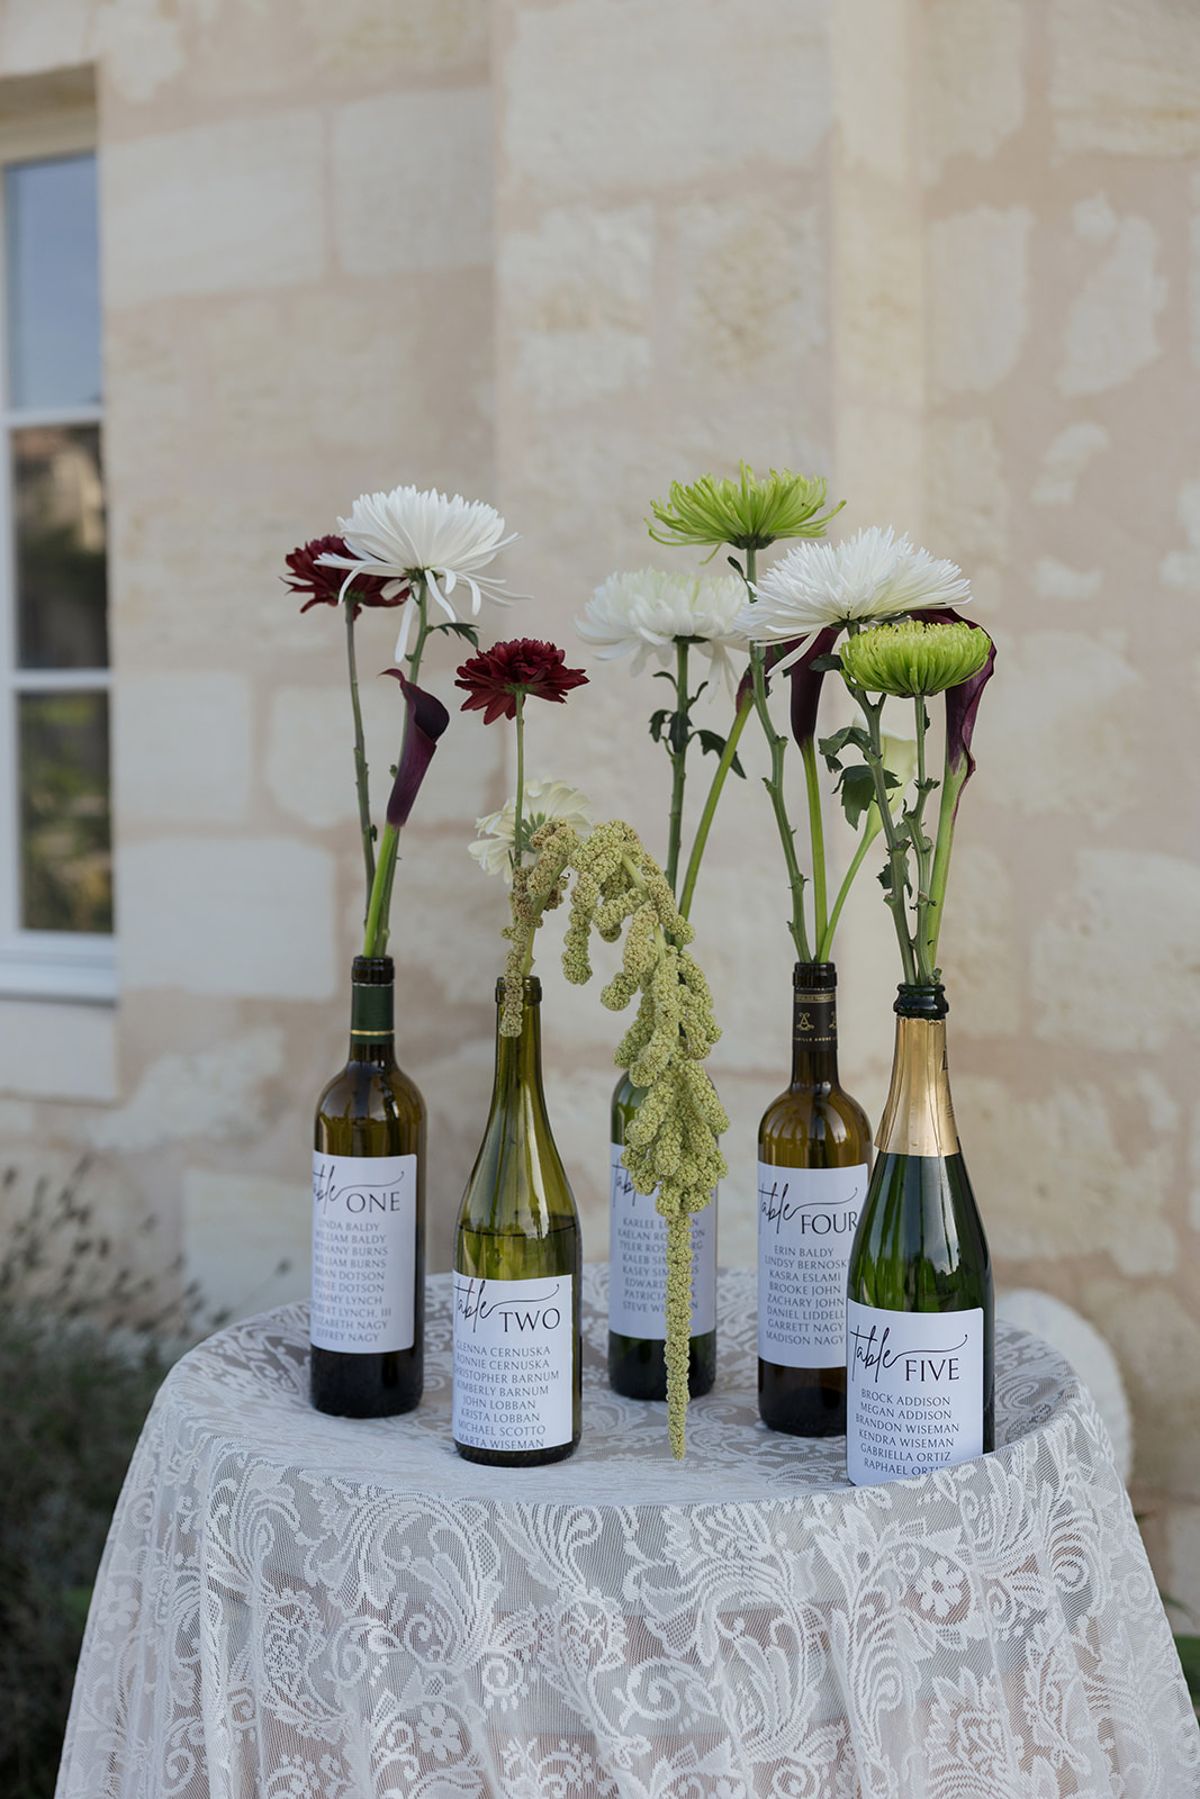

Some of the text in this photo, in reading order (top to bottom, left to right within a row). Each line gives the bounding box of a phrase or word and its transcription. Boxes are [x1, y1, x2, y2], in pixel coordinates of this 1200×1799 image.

[346, 1191, 400, 1213] ONE
[801, 1211, 858, 1235] FOUR
[351, 1234, 386, 1244] BALDY
[352, 1247, 388, 1257] BURNS
[774, 1245, 834, 1258] ERIN BALDY
[350, 1259, 386, 1269] BURNS
[623, 1264, 650, 1276] KASEY
[797, 1259, 848, 1270] BERNOSK
[339, 1271, 385, 1281] DOTSON
[624, 1277, 666, 1289] EDWARD
[769, 1269, 841, 1283] KASRA ESLAMI
[339, 1283, 385, 1293] DOTSON
[769, 1281, 841, 1297] BROOKE JOHN
[345, 1295, 382, 1305] LYNCH
[622, 1300, 648, 1313] STEVE
[767, 1292, 845, 1309] ZACHARY JOHN
[767, 1305, 845, 1320] DANIEL LIDDELL
[357, 1320, 388, 1330] NAGY
[499, 1308, 560, 1332] TWO
[767, 1318, 844, 1333] GARRETT NAGY
[348, 1332, 378, 1342] NAGY
[766, 1330, 844, 1345] MADISON NAGY
[490, 1346, 551, 1358] CERNUSKA
[850, 1325, 968, 1383] table FIVE
[489, 1360, 550, 1371] CERNUSKA
[512, 1370, 559, 1384] BARNUM
[499, 1385, 549, 1397] BARNUM
[861, 1388, 950, 1407] BROCK ADDISON
[463, 1395, 536, 1411] JOHN LOBBAN
[860, 1401, 952, 1420] MEGAN ADDISON
[493, 1413, 540, 1424] LOBBAN
[855, 1413, 960, 1435] BRANDON WISEMAN
[458, 1420, 546, 1437] MICHAEL SCOTTO
[490, 1439, 545, 1450] WISEMAN
[859, 1428, 955, 1449] KENDRA WISEMAN
[860, 1442, 951, 1462] GABRIELLA ORTIZ
[864, 1457, 946, 1476] RAPHAEL ORT
